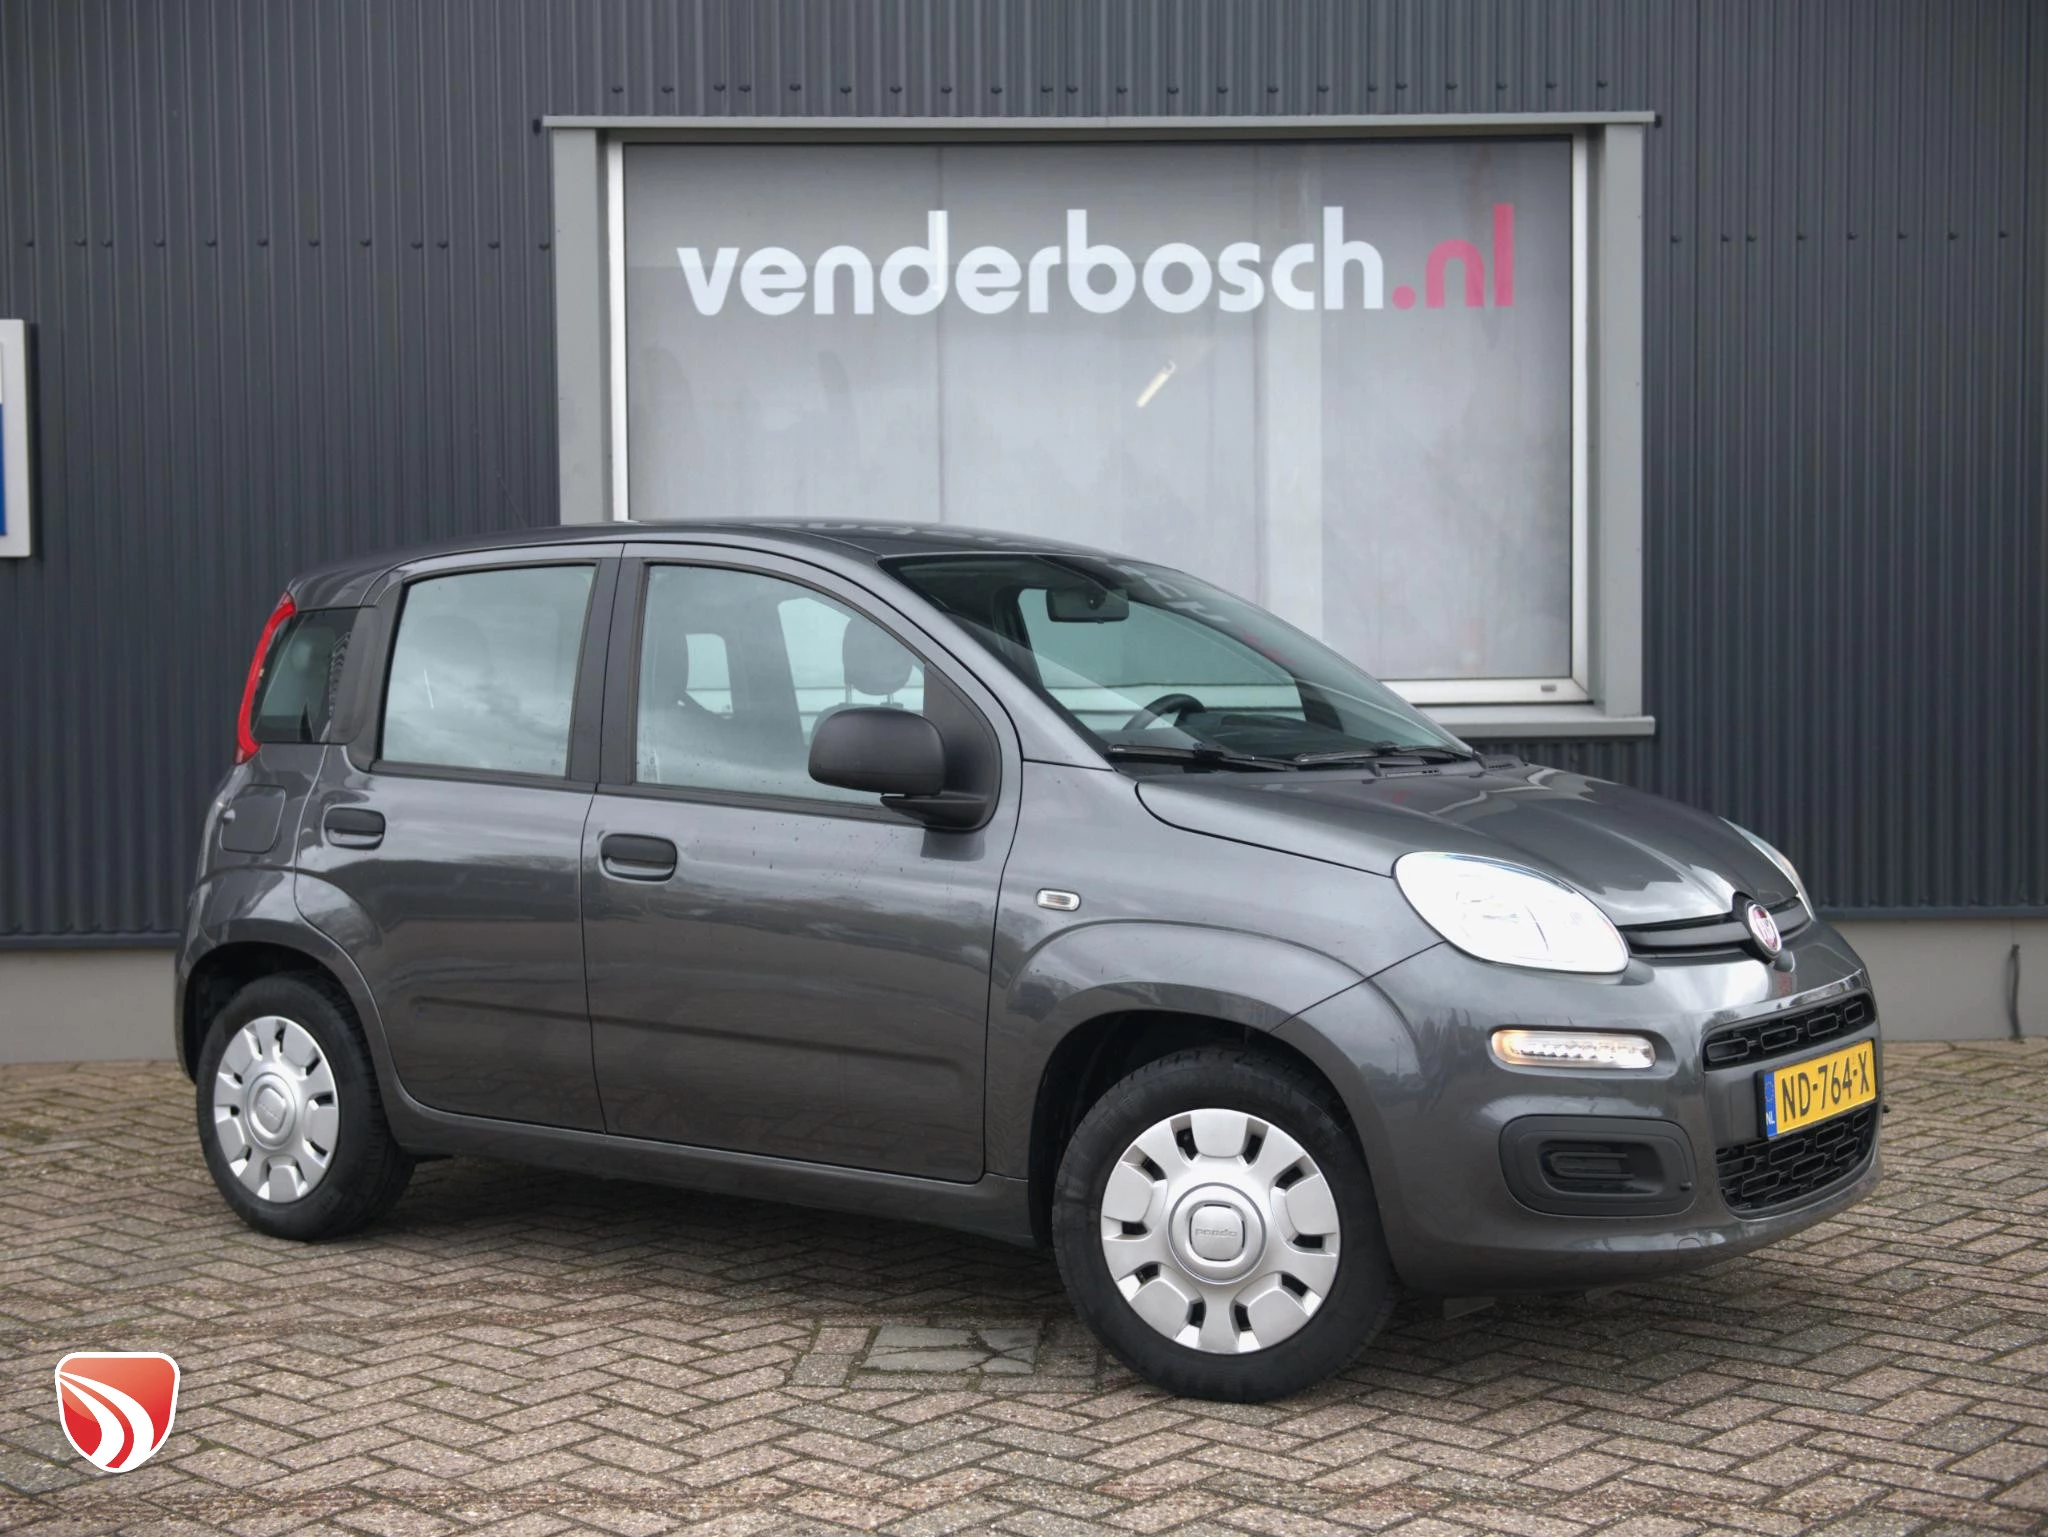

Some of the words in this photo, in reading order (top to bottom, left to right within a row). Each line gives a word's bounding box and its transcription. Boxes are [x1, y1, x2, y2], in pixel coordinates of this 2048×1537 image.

[677, 204, 1514, 315] venderbosch.nl
[1765, 1112, 1775, 1126] NL
[1781, 1050, 1870, 1122] ND-764-X
